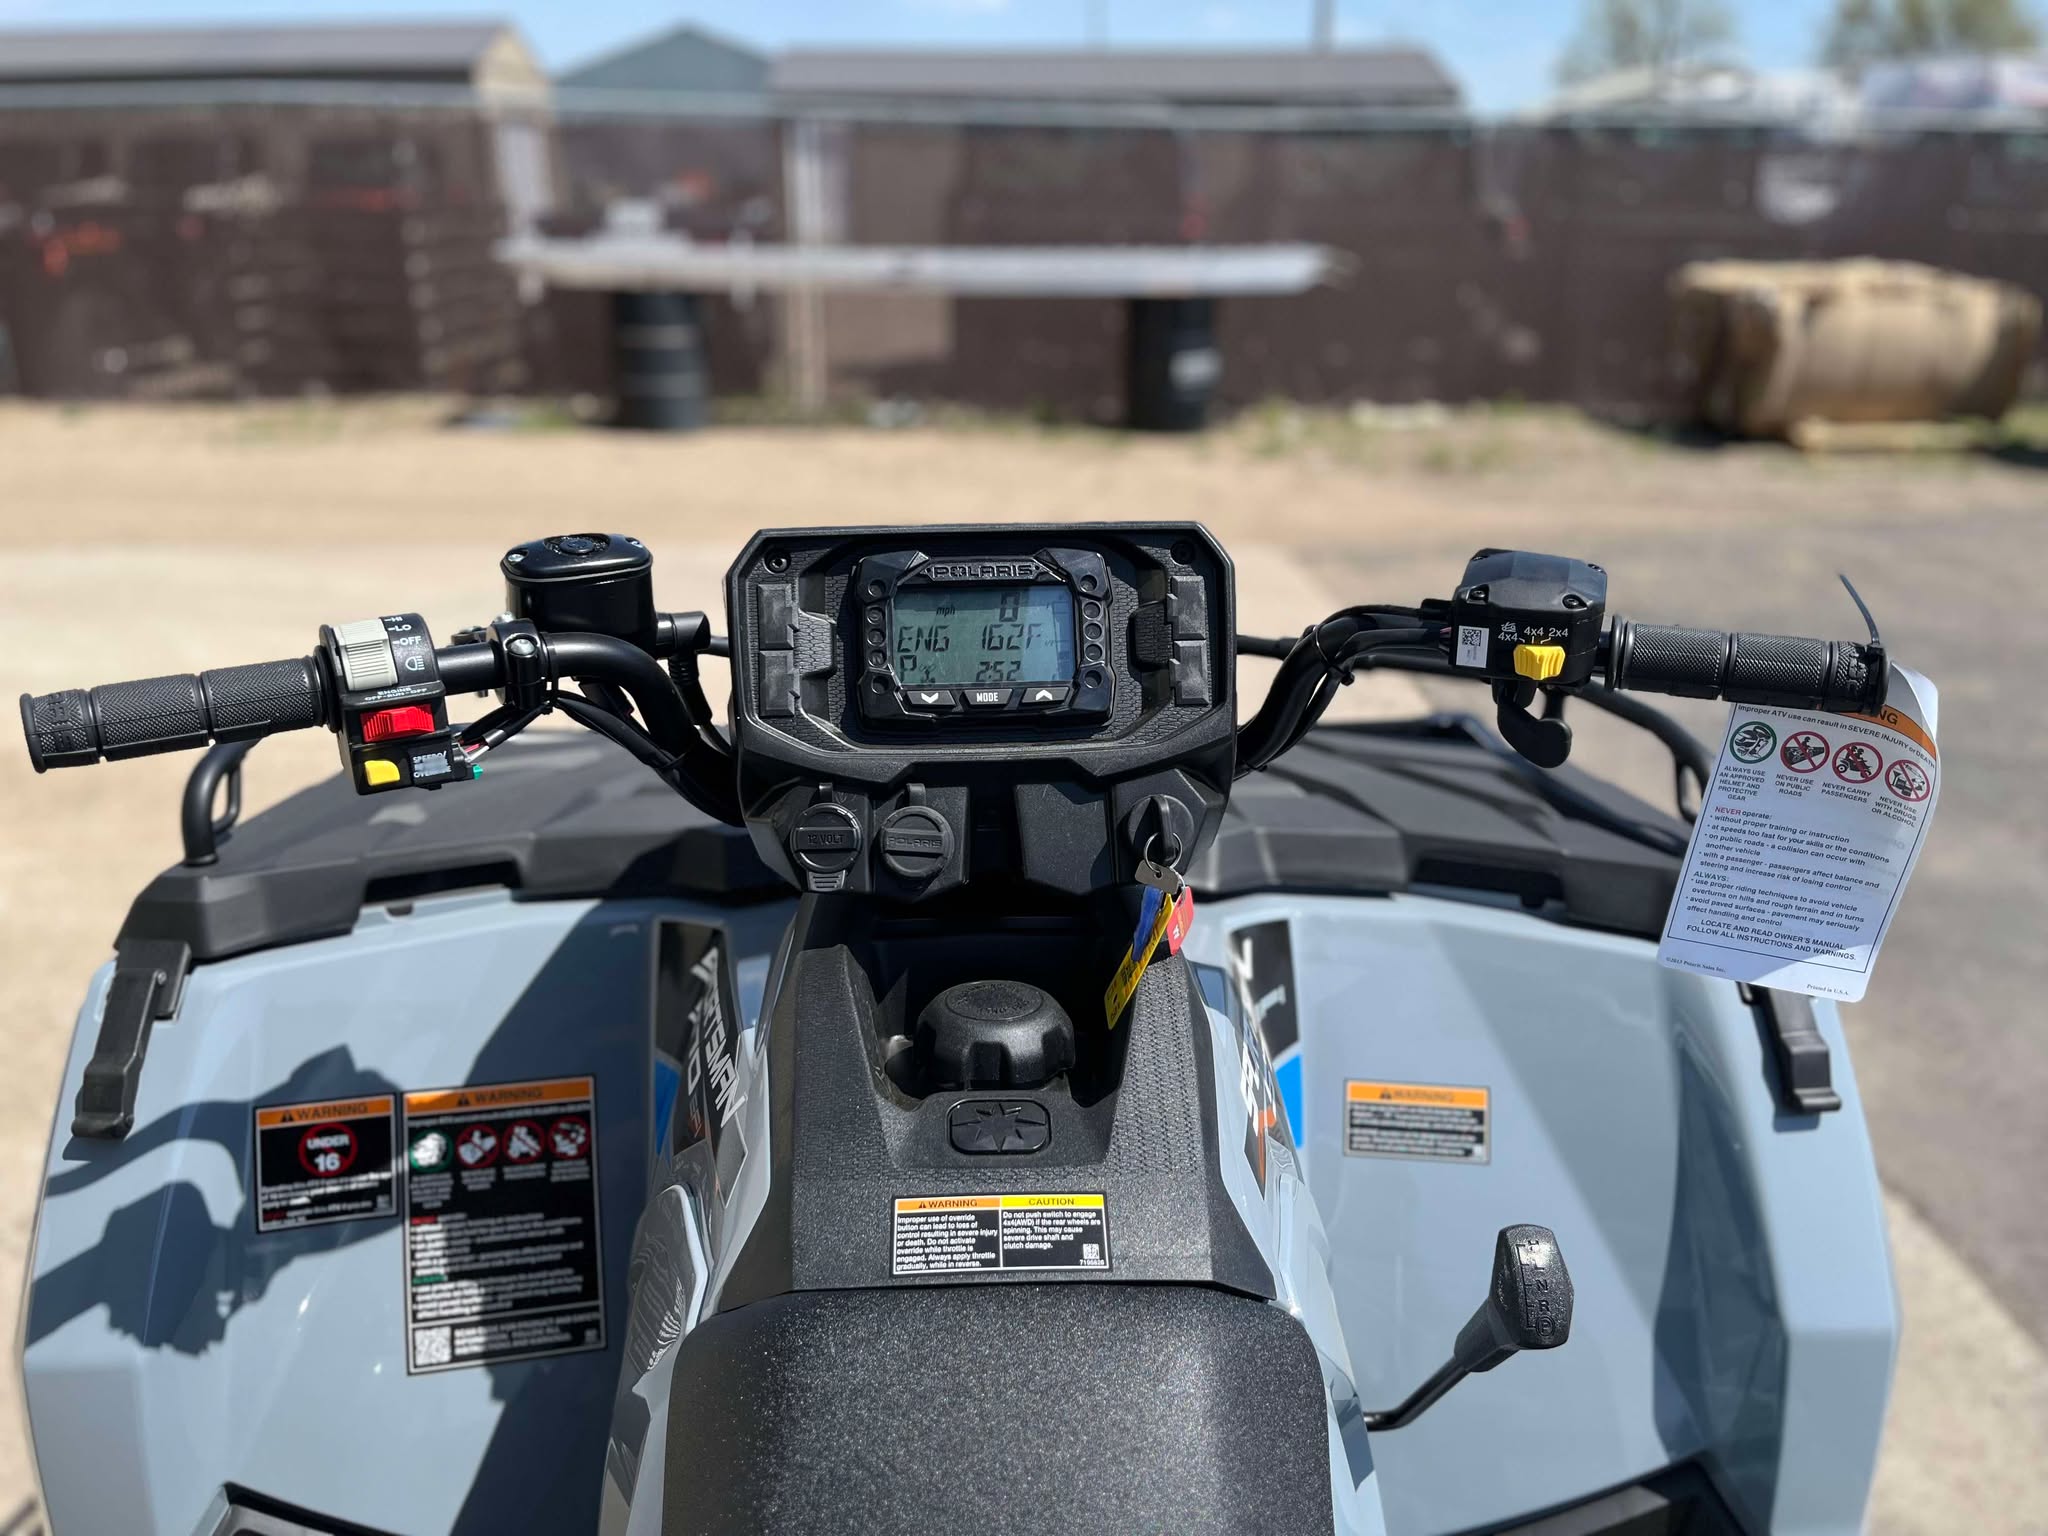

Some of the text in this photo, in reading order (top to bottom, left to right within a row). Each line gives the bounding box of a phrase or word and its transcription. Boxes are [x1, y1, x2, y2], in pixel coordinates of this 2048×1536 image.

[934, 564, 1033, 578] POLARIS
[936, 605, 955, 616] mph
[999, 592, 1021, 622] 0
[982, 623, 1042, 650] 162F
[1498, 632, 1518, 641] 4x4
[1524, 627, 1544, 636] 4x4
[1549, 628, 1569, 637] 2x4
[400, 636, 422, 645] OFF
[898, 626, 950, 652] ENG
[378, 687, 412, 695] ENGINE
[976, 692, 998, 702] MODE
[1738, 704, 1770, 715] Improper
[1771, 710, 1788, 718] ATV
[1817, 719, 1839, 729] result
[1848, 724, 1880, 738] SEVERE
[1881, 733, 1909, 749] INJURY
[1724, 765, 1752, 775] ALWAYS
[1719, 779, 1745, 787] HELMET
[1730, 773, 1765, 783] APPROVED
[1776, 774, 1799, 782] NEVER
[1718, 785, 1758, 796] PROTECTIVE
[1778, 789, 1803, 797] ROADS
[1786, 783, 1811, 791] PUBLIC
[1822, 782, 1871, 797] NEVER CARRY
[1727, 793, 1746, 801] GEAR
[1821, 789, 1868, 803] PASSENGERS
[1875, 801, 1917, 821] WITH DRUGS
[1879, 796, 1917, 814] NEVER USE
[1715, 806, 1773, 820] NEVER operate:
[1883, 811, 1915, 828] ALCOHOL
[1714, 815, 1741, 824] without
[1742, 819, 1767, 829] proper
[1768, 823, 1798, 835] training
[1809, 830, 1850, 843] instruction
[808, 834, 843, 844] 12 VOLT
[888, 836, 942, 848] POLARIS
[1705, 842, 1761, 856] another vehicle
[1720, 835, 1742, 844] public
[1743, 839, 1765, 847] roads
[1777, 845, 1809, 855] collision
[1810, 850, 1824, 858] can
[1825, 853, 1848, 862] occur
[1849, 858, 1866, 866] with
[1693, 871, 1729, 882] ALWAYS:
[1700, 860, 1729, 871] steering
[1730, 865, 1744, 873] and
[1745, 867, 1775, 878] increase
[1776, 873, 1791, 881] risk
[1801, 876, 1824, 888] losing
[1825, 882, 1852, 892] control
[1725, 855, 1763, 867] passenger
[1768, 862, 1811, 875] passengers
[1812, 870, 1834, 879] affect
[1834, 874, 1863, 885] balance
[1864, 880, 1880, 889] and
[1710, 881, 1734, 890] proper
[1735, 884, 1757, 894] riding
[1758, 889, 1798, 901] techniques
[1809, 898, 1830, 907] avoid
[1831, 902, 1858, 912] vehicle
[1687, 905, 1707, 913] affect
[1709, 910, 1740, 921] handling
[1756, 917, 1783, 926] control
[1690, 896, 1860, 932] avoid paved surfaces pavement may seriously
[1700, 919, 1732, 930] LOCATE
[1751, 927, 1772, 937] READ
[1774, 932, 1811, 944] OWNER'S
[1686, 925, 1720, 935] FOLLOW
[1720, 930, 1735, 939] ALL
[1736, 934, 1793, 949] INSTRUCTIONS
[1813, 948, 1856, 960] WARNINGS.
[295, 1103, 368, 1119] WARNING
[307, 1134, 349, 1149] UNDER
[314, 1153, 340, 1172] 16
[929, 1199, 977, 1208] WARNING
[1028, 1198, 1075, 1206] CAUTION
[898, 1216, 927, 1224] Improper
[940, 1214, 948, 1222] of
[1025, 1211, 1042, 1219] push
[897, 1223, 918, 1231] button
[897, 1231, 920, 1239] control
[921, 1230, 949, 1238] resulting
[980, 1228, 998, 1237] injury
[1536, 1279, 1548, 1291] N
